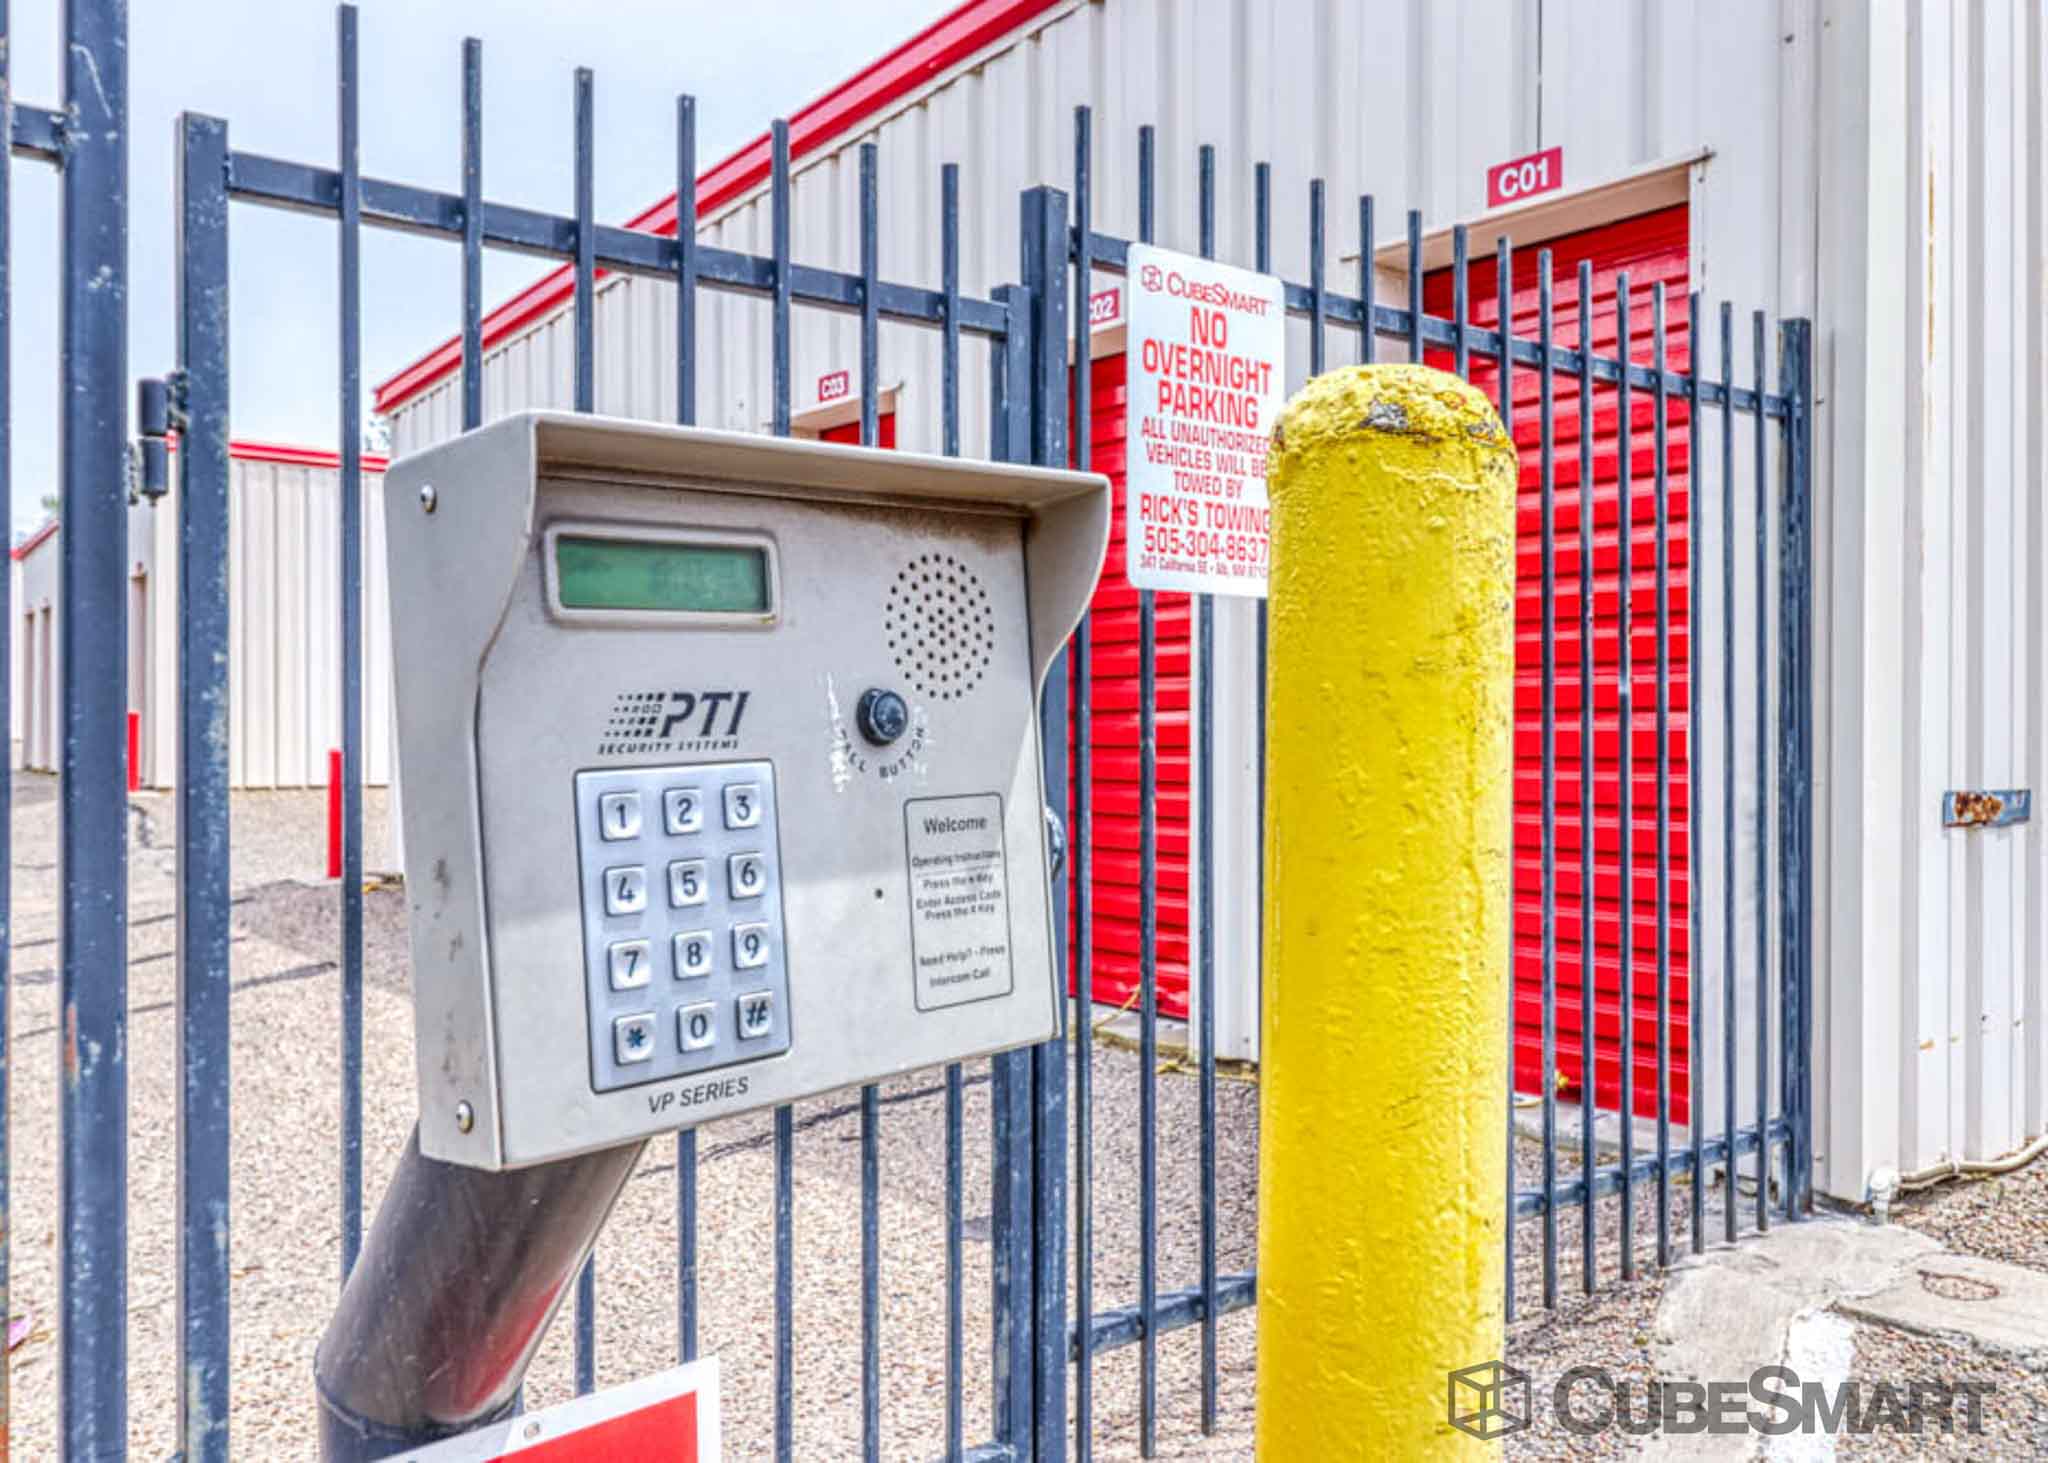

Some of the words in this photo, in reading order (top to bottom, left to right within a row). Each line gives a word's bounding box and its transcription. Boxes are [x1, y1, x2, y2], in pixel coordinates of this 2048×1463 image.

[1498, 156, 1549, 198] C01
[1190, 305, 1228, 349] NO
[1142, 337, 1272, 395] OVERNIGHT
[1157, 378, 1259, 429] PARKING
[1141, 415, 1167, 440] ALL
[1145, 442, 1212, 472] VEHICLES
[1216, 451, 1247, 476] WILL
[1173, 471, 1222, 497] TOWED
[1226, 478, 1244, 500] BY
[1139, 492, 1199, 527] RICK'S
[658, 690, 751, 739] PTI
[616, 803, 628, 830] 1
[677, 797, 694, 826] 2
[735, 794, 751, 822] 3
[922, 815, 988, 836] Welcome
[617, 876, 635, 905] 4
[682, 870, 698, 898] 5
[741, 861, 757, 888] 6
[624, 950, 640, 979] 7
[686, 941, 702, 968] 8
[744, 933, 760, 960] 9
[647, 1091, 675, 1114] VP
[679, 1075, 749, 1107] SERIES
